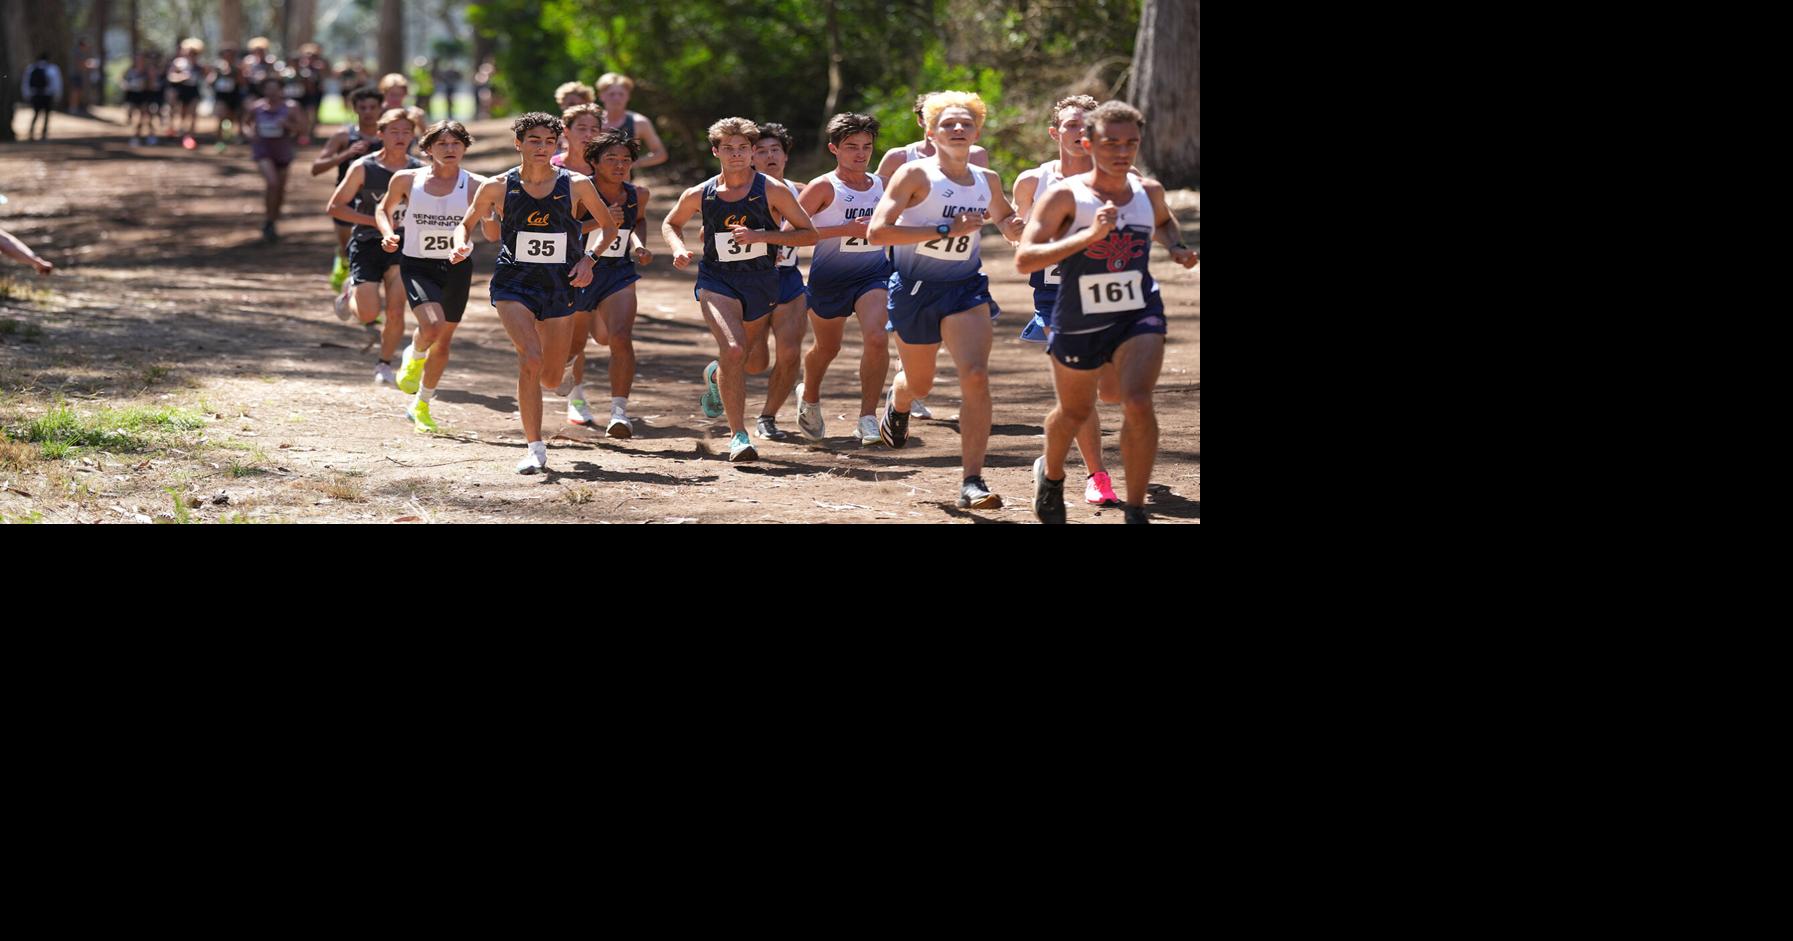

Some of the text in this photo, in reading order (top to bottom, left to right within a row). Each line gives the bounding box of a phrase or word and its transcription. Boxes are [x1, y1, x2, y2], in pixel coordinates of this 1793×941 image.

[527, 210, 549, 227] Cal
[845, 208, 859, 220] UC
[527, 239, 555, 256] 35
[610, 236, 622, 250] 3
[924, 235, 970, 253] 218
[1087, 281, 1135, 304] 161
